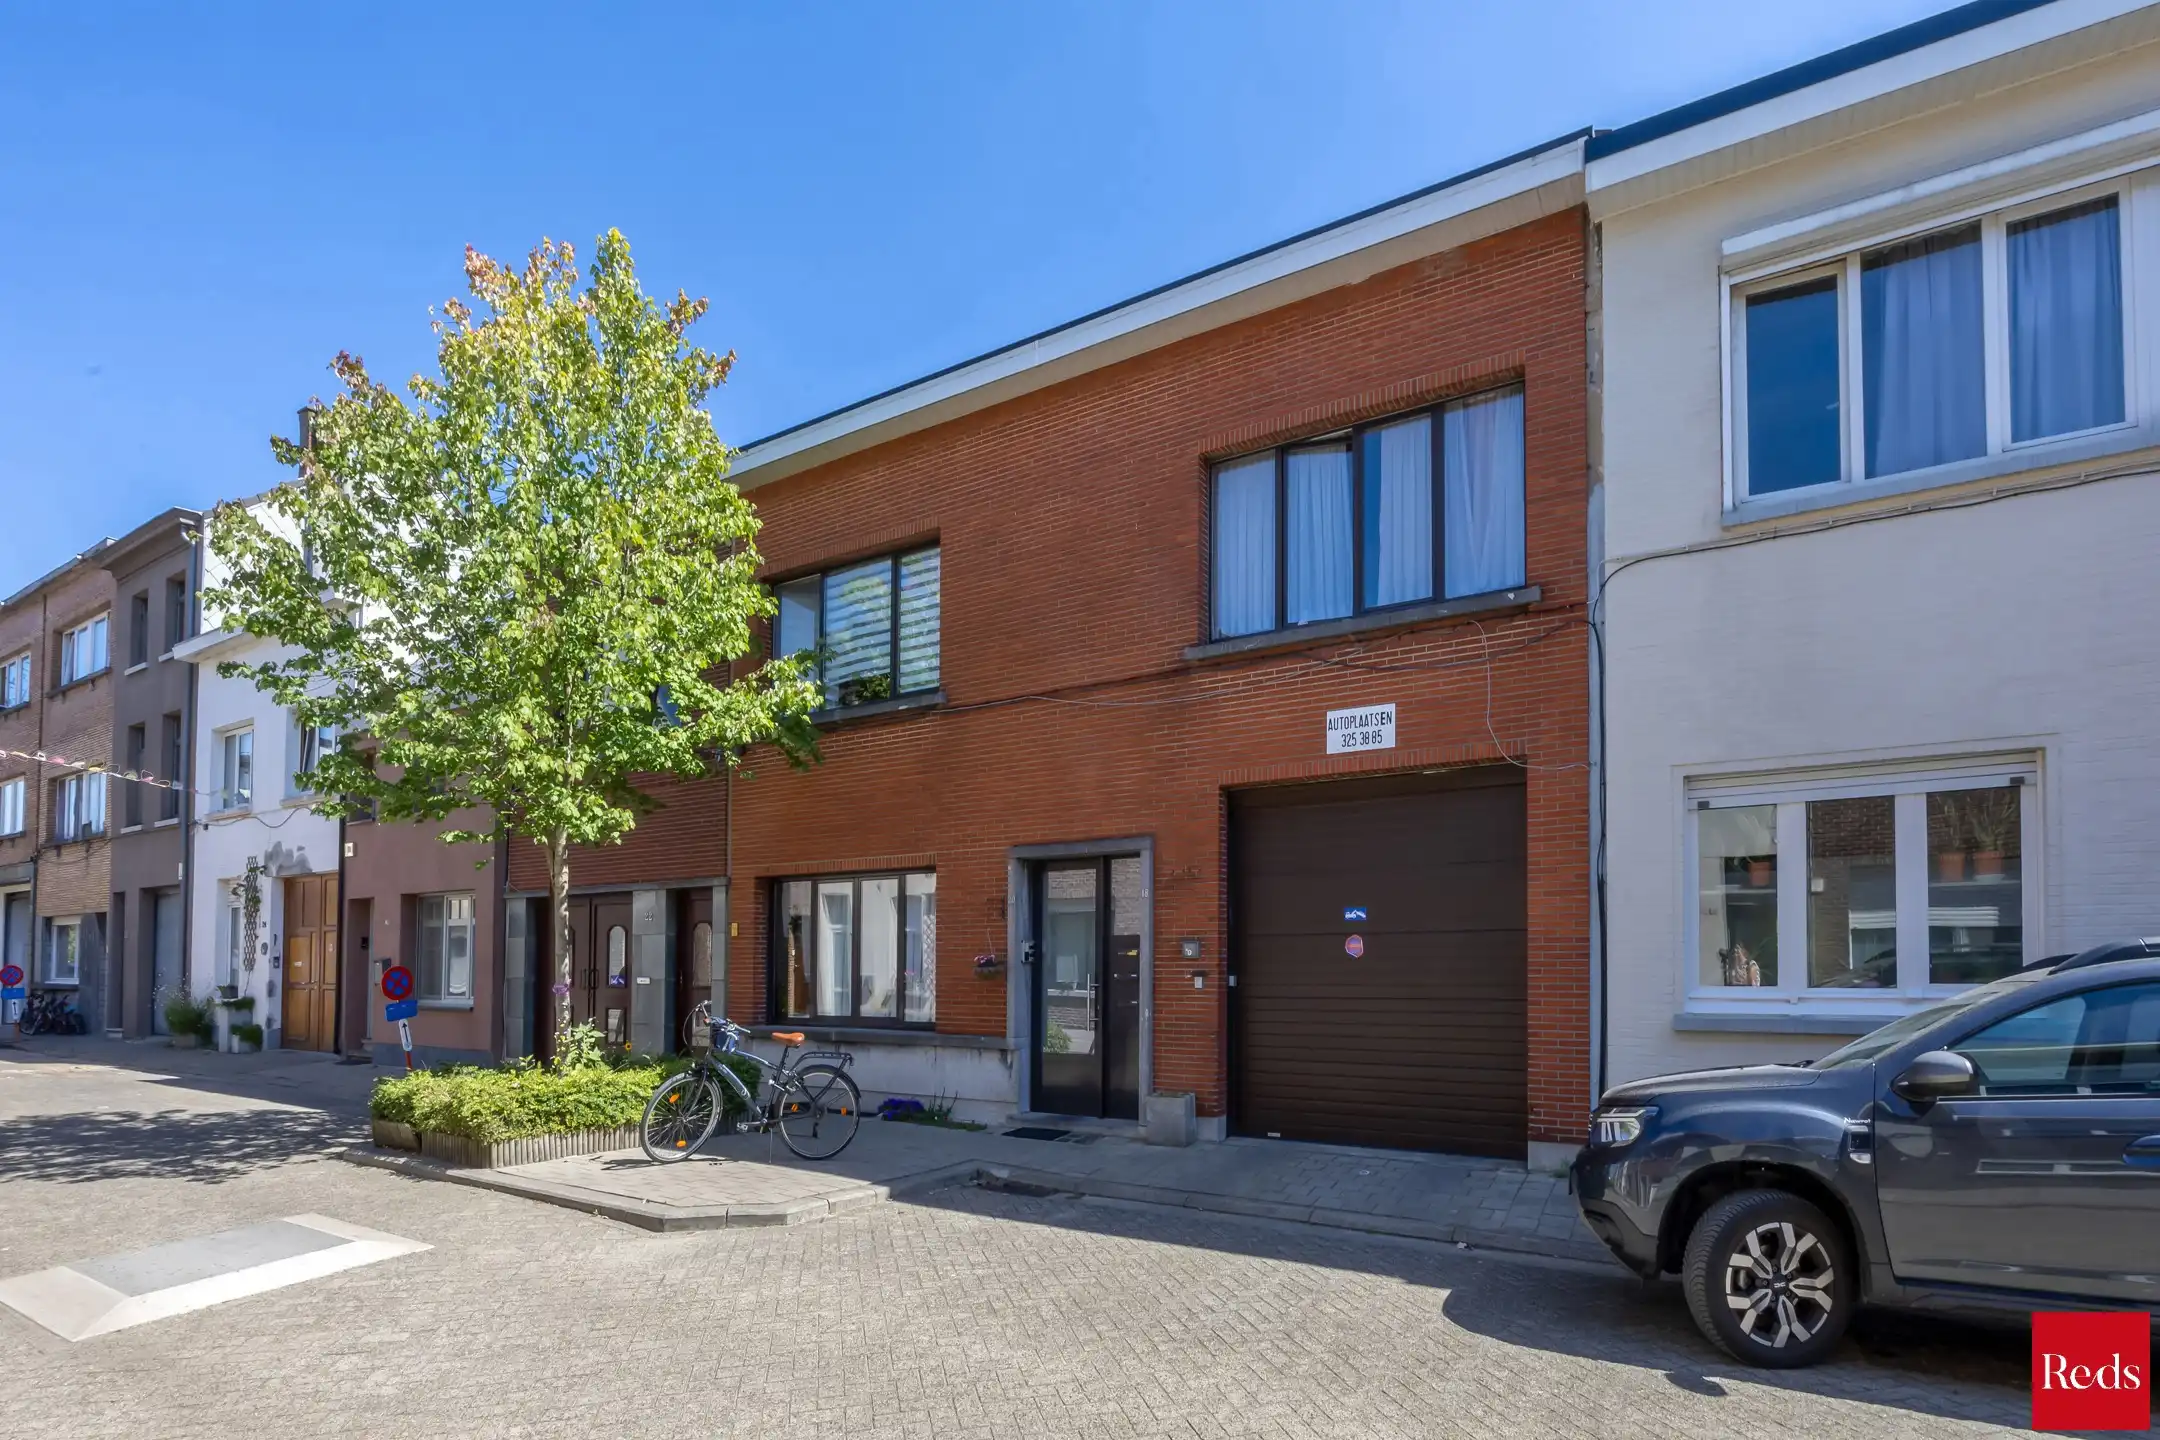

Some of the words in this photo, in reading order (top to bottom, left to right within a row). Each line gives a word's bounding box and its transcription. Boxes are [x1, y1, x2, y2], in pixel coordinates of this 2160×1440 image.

[1328, 711, 1393, 731] AUTOPLAATSEN
[1341, 732, 1357, 748] 325
[1359, 731, 1370, 746] 38
[1371, 729, 1383, 744] 85
[1141, 888, 1149, 898] 18
[644, 911, 653, 921] 22
